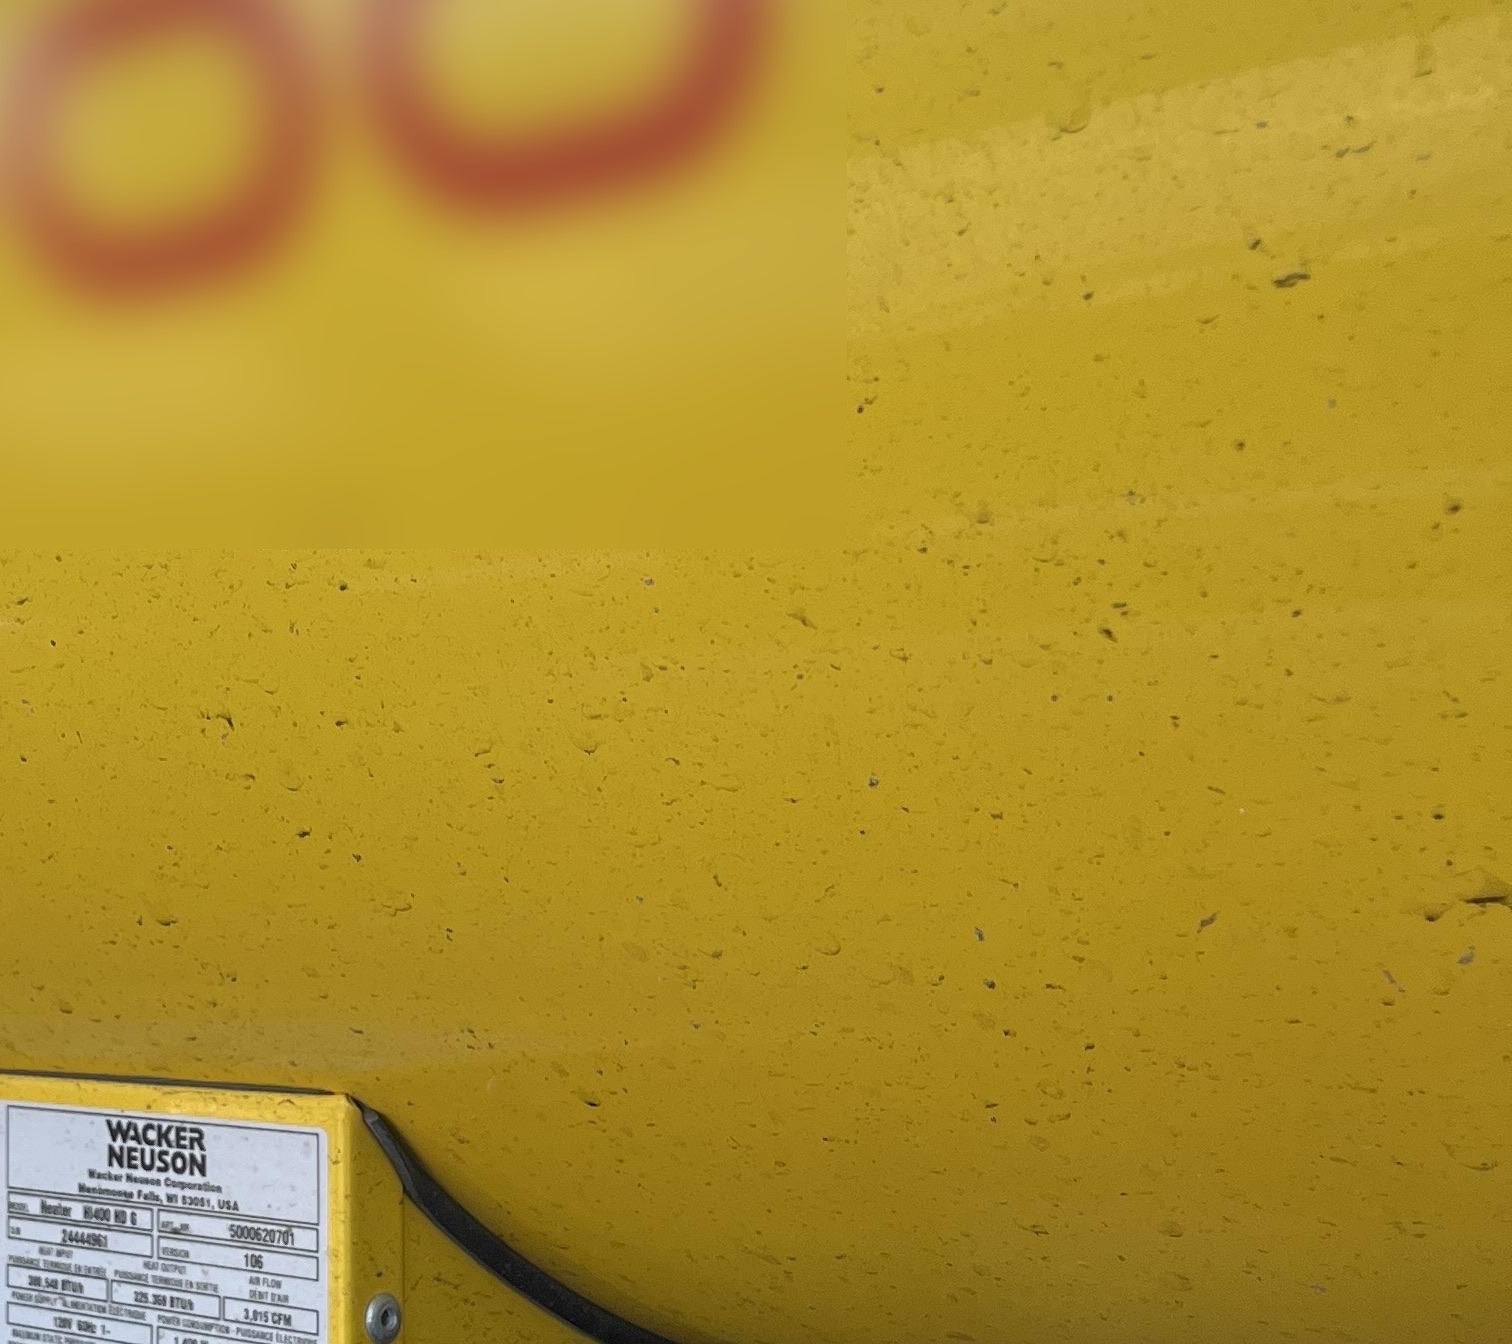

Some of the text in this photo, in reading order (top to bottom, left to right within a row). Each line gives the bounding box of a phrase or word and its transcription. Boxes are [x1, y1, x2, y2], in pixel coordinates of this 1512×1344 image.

[105, 1119, 205, 1151] WACKER
[107, 1144, 206, 1177] NEUSON
[89, 1168, 222, 1195] Wacker Neuson Corporation
[40, 1199, 71, 1217] Heater
[217, 1198, 239, 1212] USA
[229, 1223, 294, 1246] 5000620701
[249, 1275, 282, 1290] AIR FLOW
[271, 1312, 291, 1326] CFM
